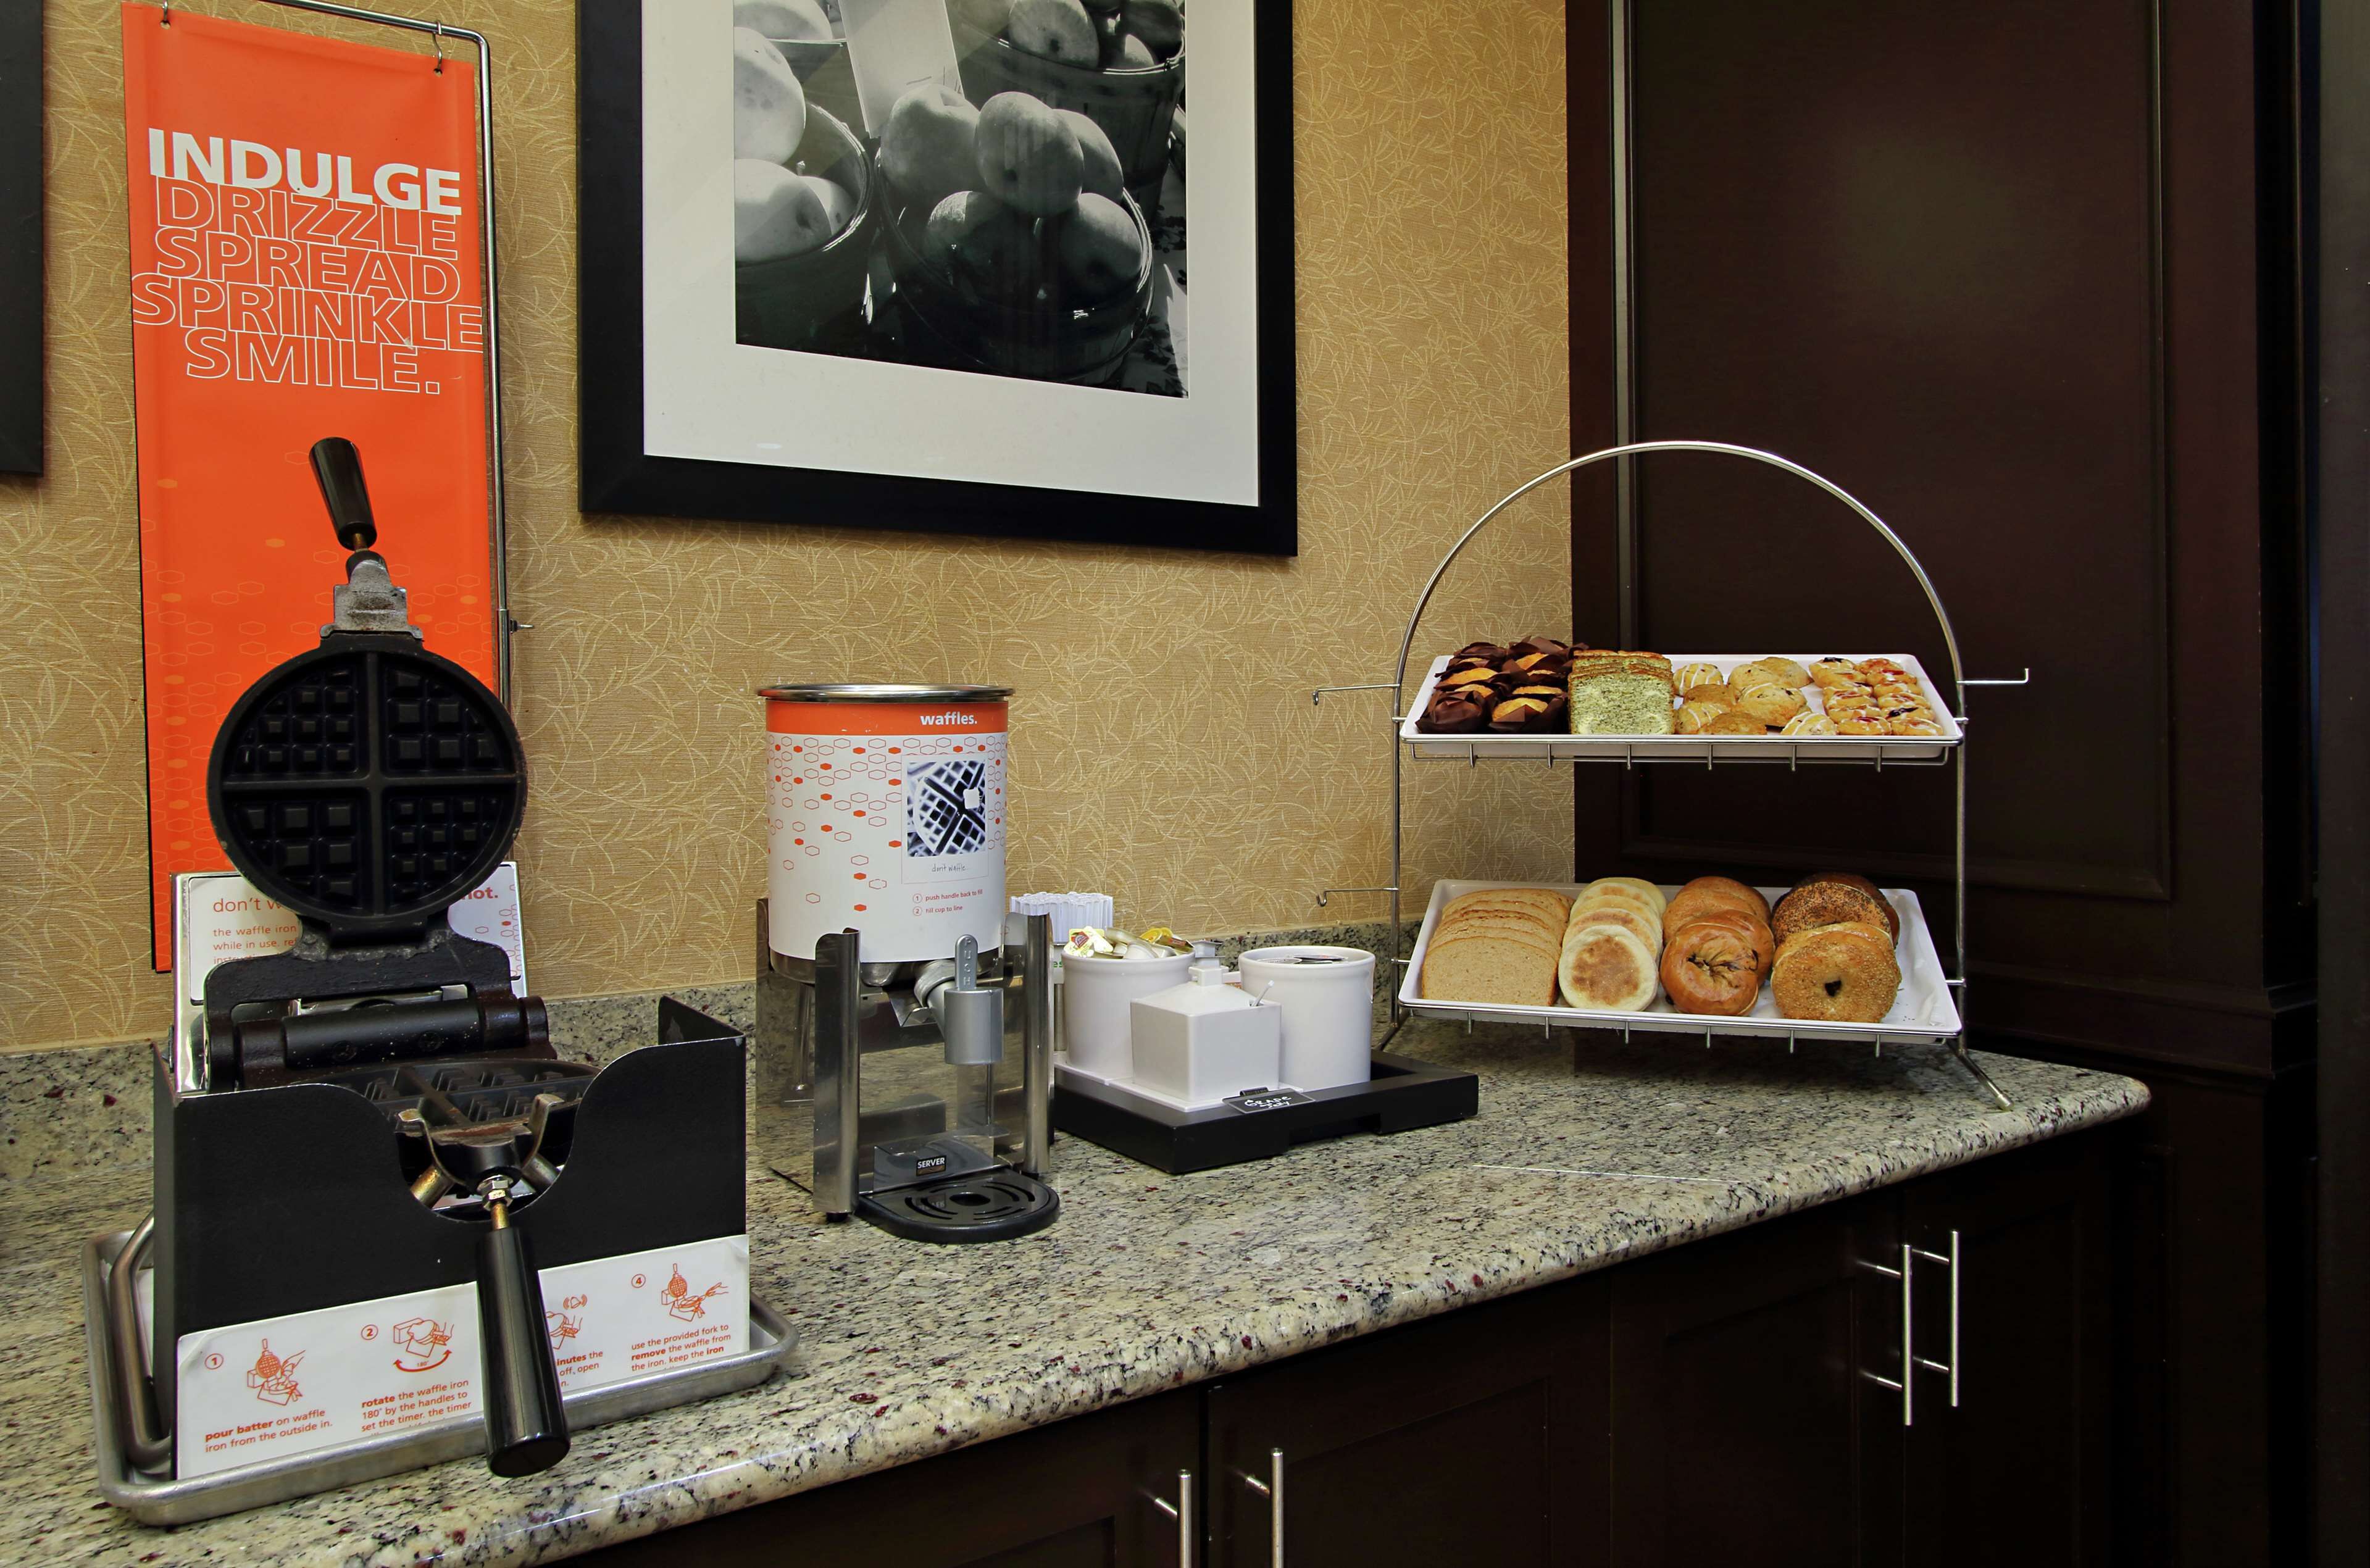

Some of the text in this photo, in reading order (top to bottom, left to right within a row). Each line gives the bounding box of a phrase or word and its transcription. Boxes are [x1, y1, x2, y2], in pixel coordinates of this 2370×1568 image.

[149, 128, 462, 215] INDULGE
[156, 176, 457, 261] DRIZZLE
[156, 227, 460, 304] SPREAD
[131, 273, 483, 353] SPRINKLE
[185, 327, 440, 394] SMILE.
[920, 711, 977, 725] waffles.
[213, 898, 261, 912] don't
[213, 928, 232, 936] the
[236, 927, 271, 935] waffle
[213, 941, 242, 950] while
[917, 1157, 945, 1169] SERVER
[632, 1334, 731, 1361] remove the waffle from
[664, 1329, 699, 1345] provided
[701, 1326, 717, 1335] fork
[556, 1351, 603, 1366] inutes the
[577, 1363, 599, 1373] open
[632, 1363, 645, 1371] the
[648, 1359, 667, 1367] iron.
[669, 1354, 689, 1364] keep
[691, 1350, 704, 1358] the
[707, 1346, 724, 1354] iron
[361, 1380, 469, 1407] rotate the waffle iron
[361, 1423, 375, 1432] set
[379, 1418, 394, 1428] the
[398, 1412, 425, 1424] timer.
[428, 1408, 444, 1417] the
[446, 1401, 472, 1412] timer
[362, 1408, 383, 1419] 180°
[385, 1406, 396, 1417] by
[400, 1402, 415, 1412] the
[419, 1395, 455, 1407] handles
[205, 1409, 325, 1443] pour batter on waffle
[205, 1420, 333, 1452] iron from the outside in.
